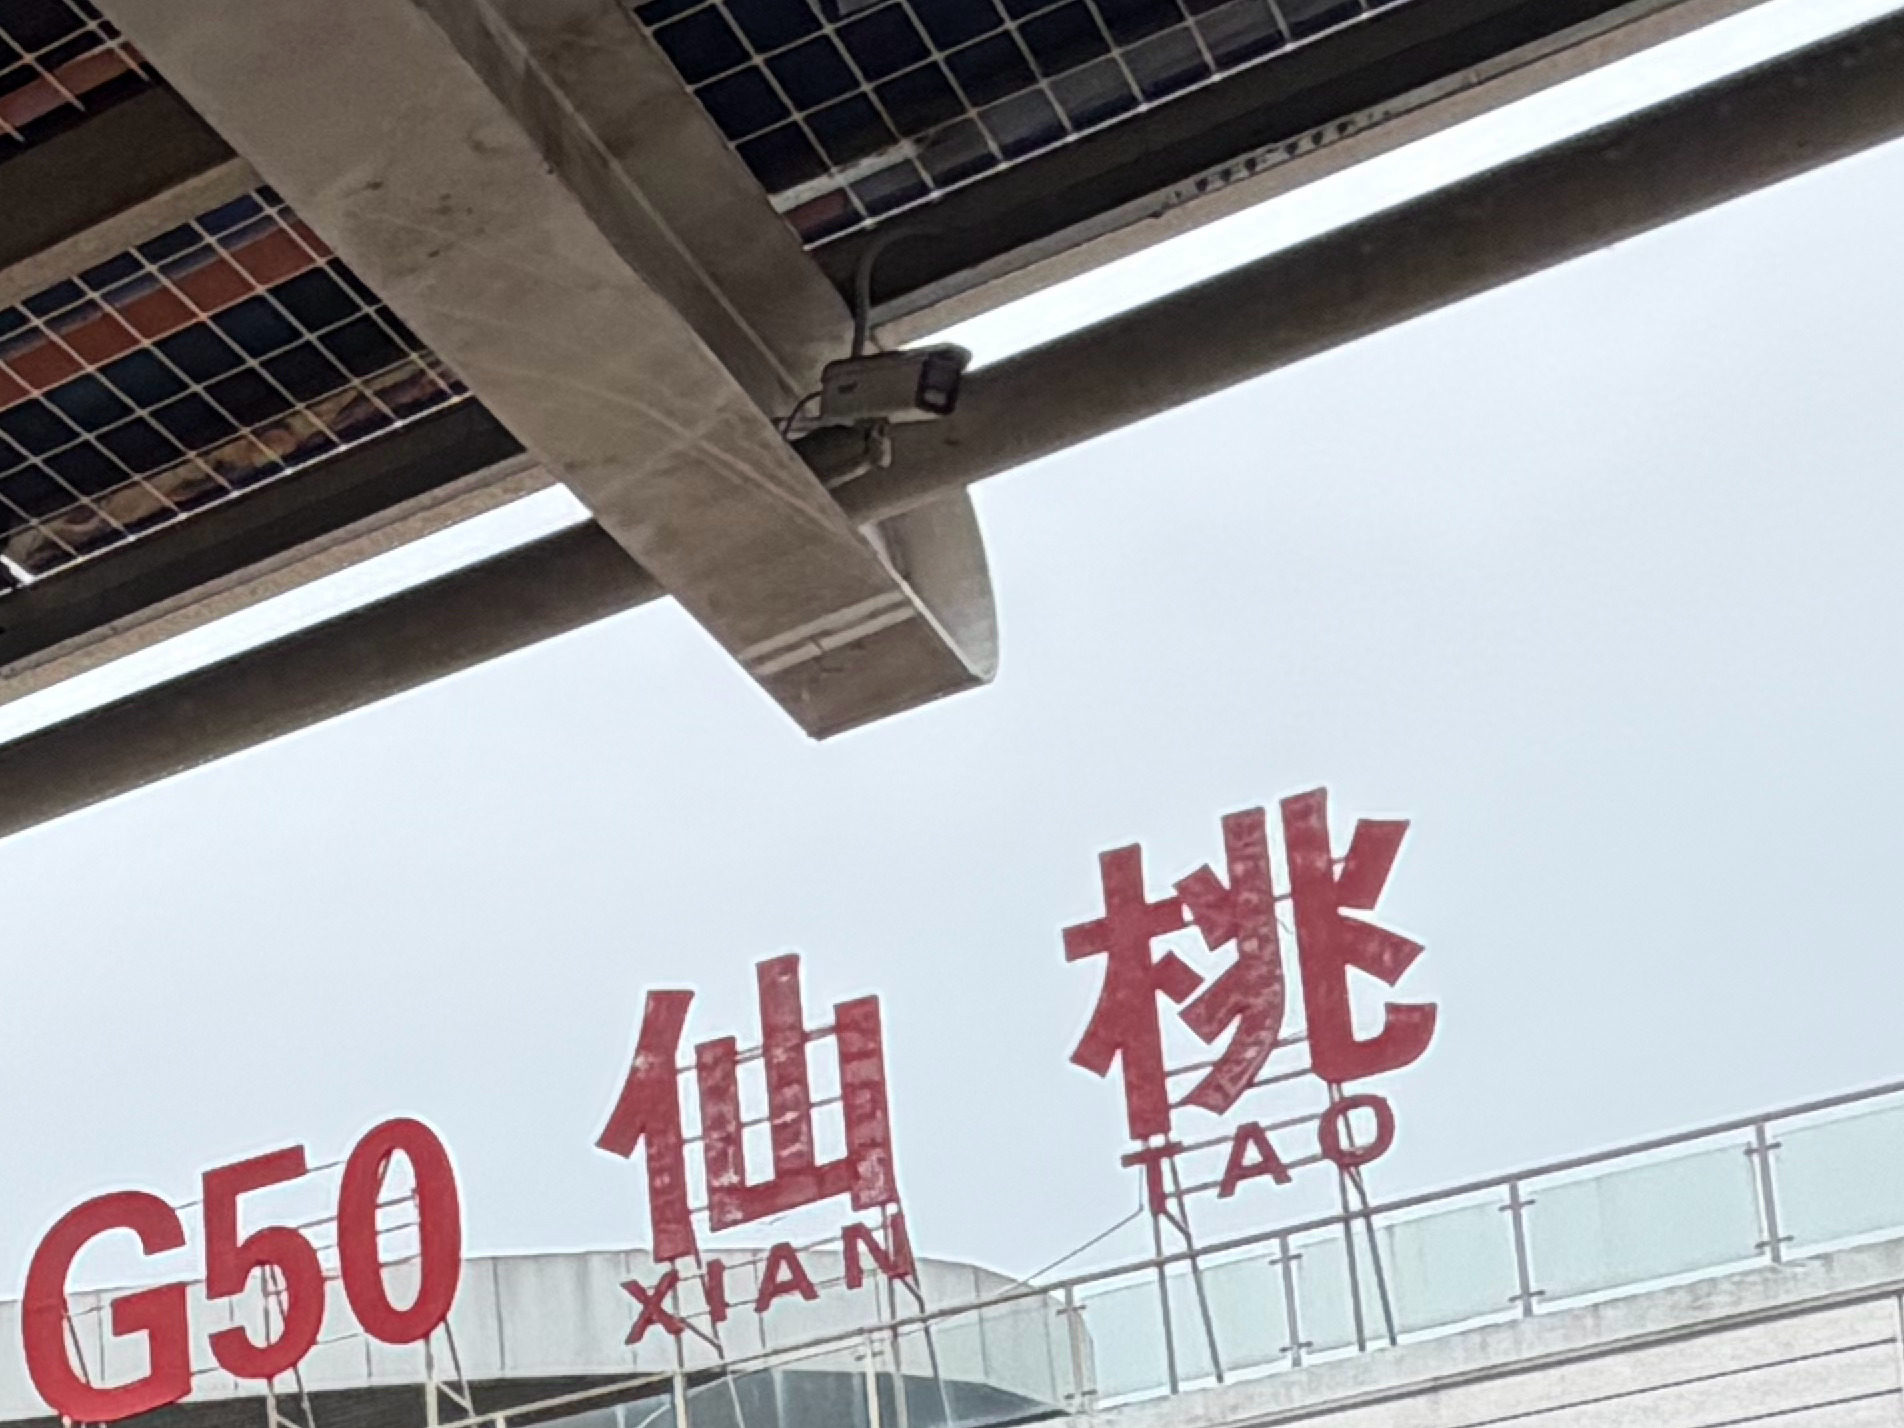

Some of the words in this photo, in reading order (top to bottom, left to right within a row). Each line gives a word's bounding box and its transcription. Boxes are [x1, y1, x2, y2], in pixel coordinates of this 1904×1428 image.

[1121, 1094, 1395, 1213] TAO
[22, 1117, 462, 1424] G50
[620, 1212, 912, 1345] XIAN
